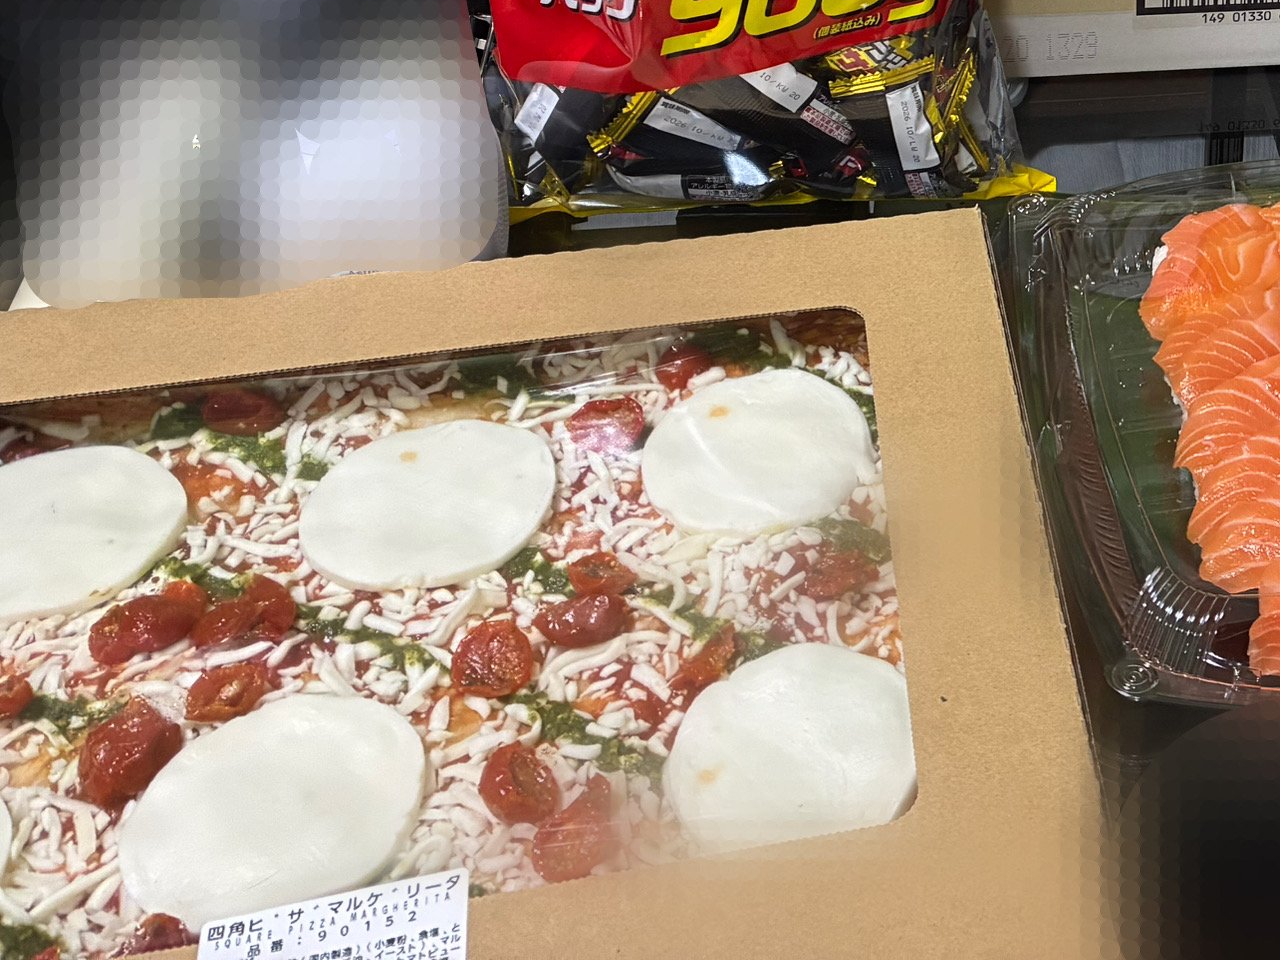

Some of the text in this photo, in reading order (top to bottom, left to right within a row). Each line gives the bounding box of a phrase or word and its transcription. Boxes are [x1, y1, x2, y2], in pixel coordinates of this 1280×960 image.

[1201, 11, 1225, 24] 149
[1232, 9, 1272, 23] 01330
[901, 101, 911, 122] 2026
[214, 890, 451, 951] SQUARE PIZZA MARGHERITA
